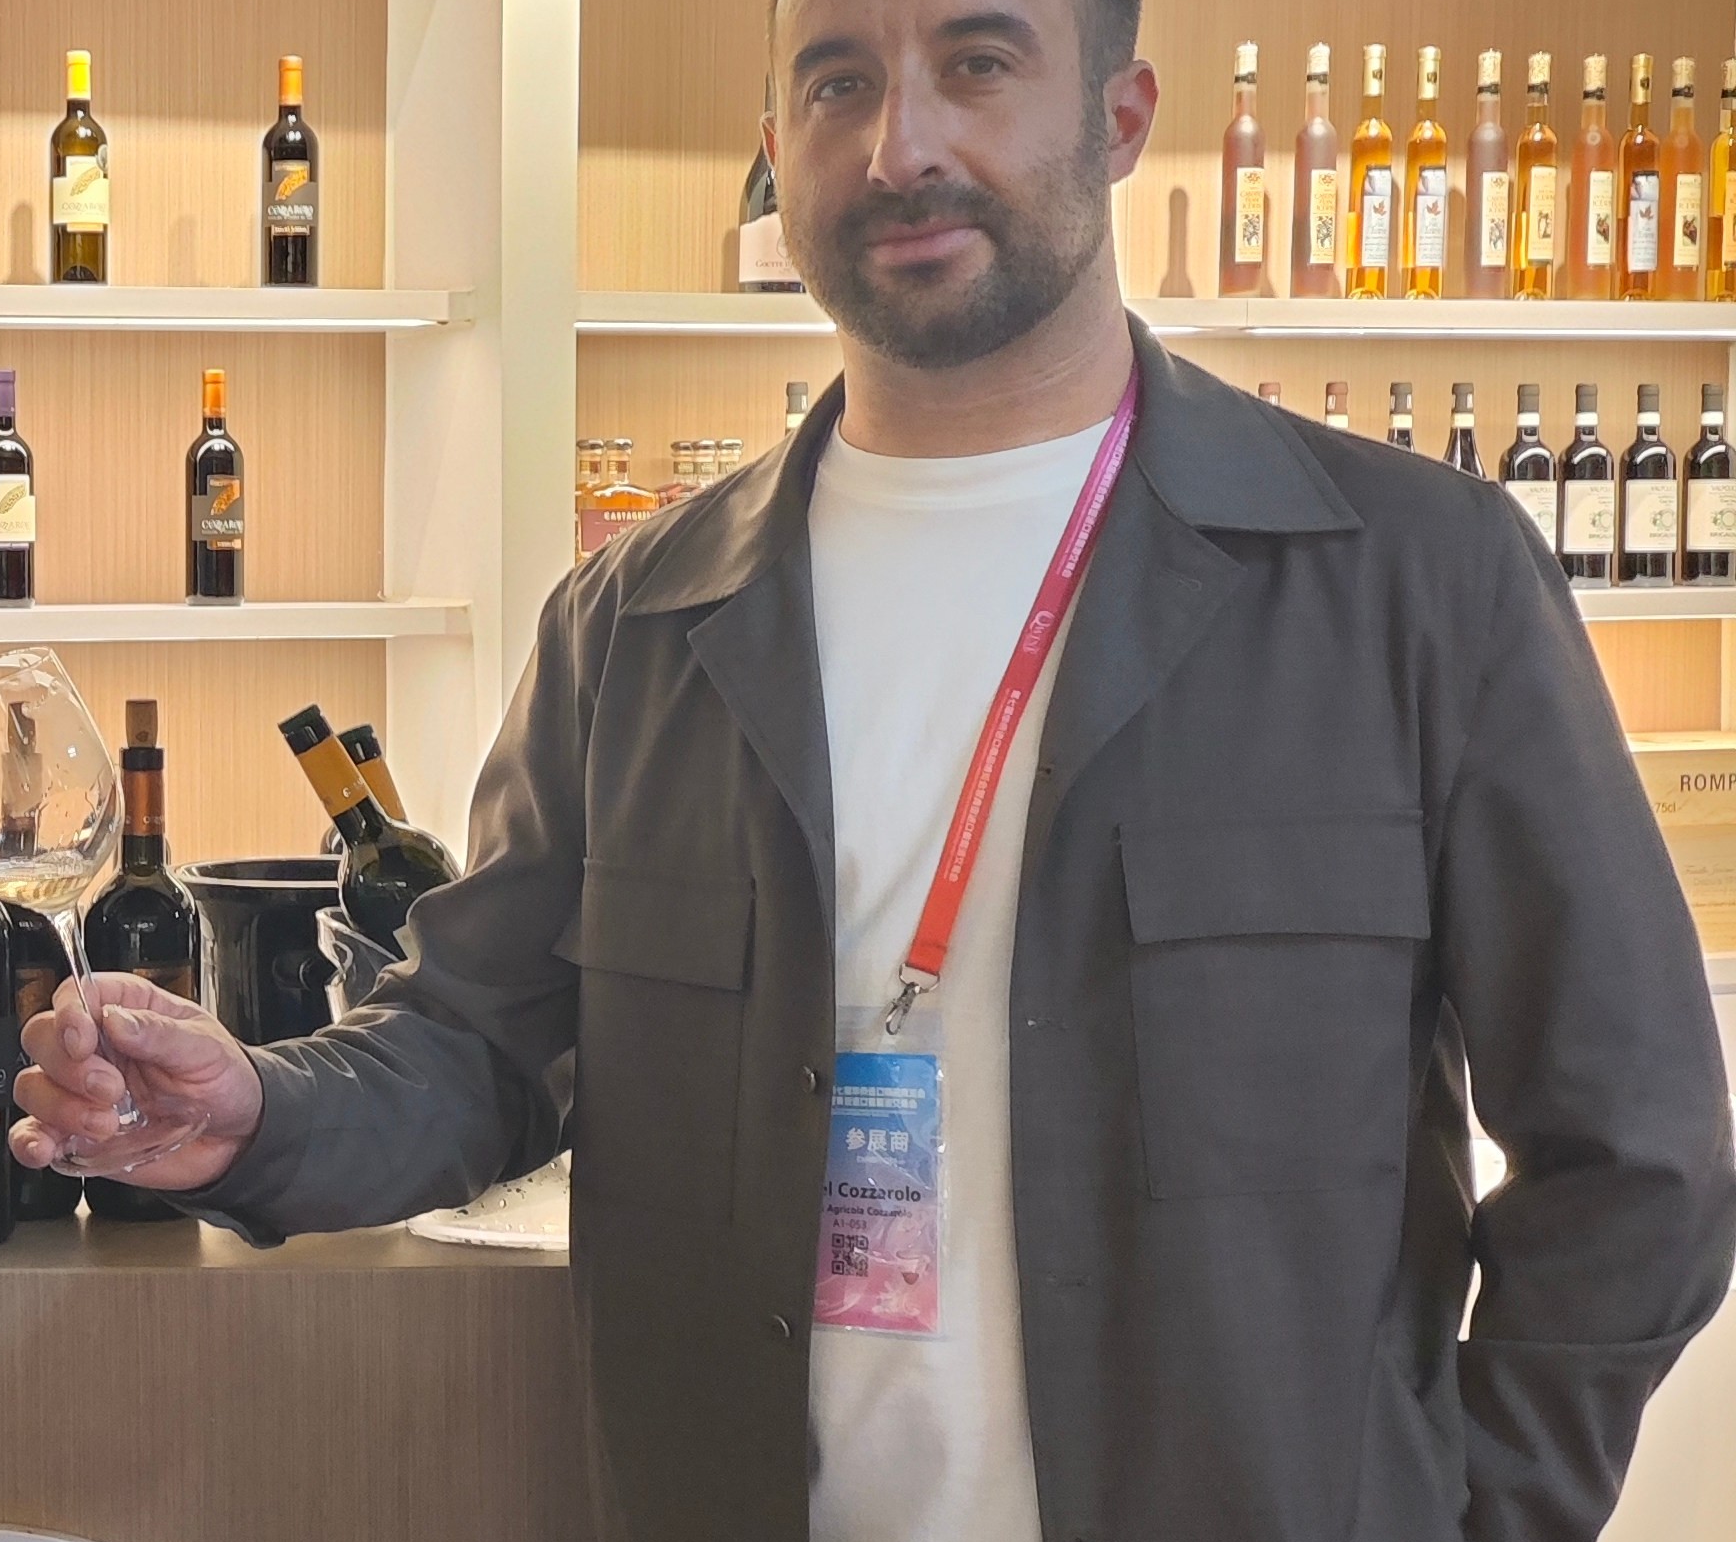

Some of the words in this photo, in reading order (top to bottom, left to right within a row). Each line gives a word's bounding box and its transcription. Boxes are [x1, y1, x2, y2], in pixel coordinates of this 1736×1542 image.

[846, 1127, 909, 1153] 参展商
[837, 1182, 922, 1202] Cozzarolo
